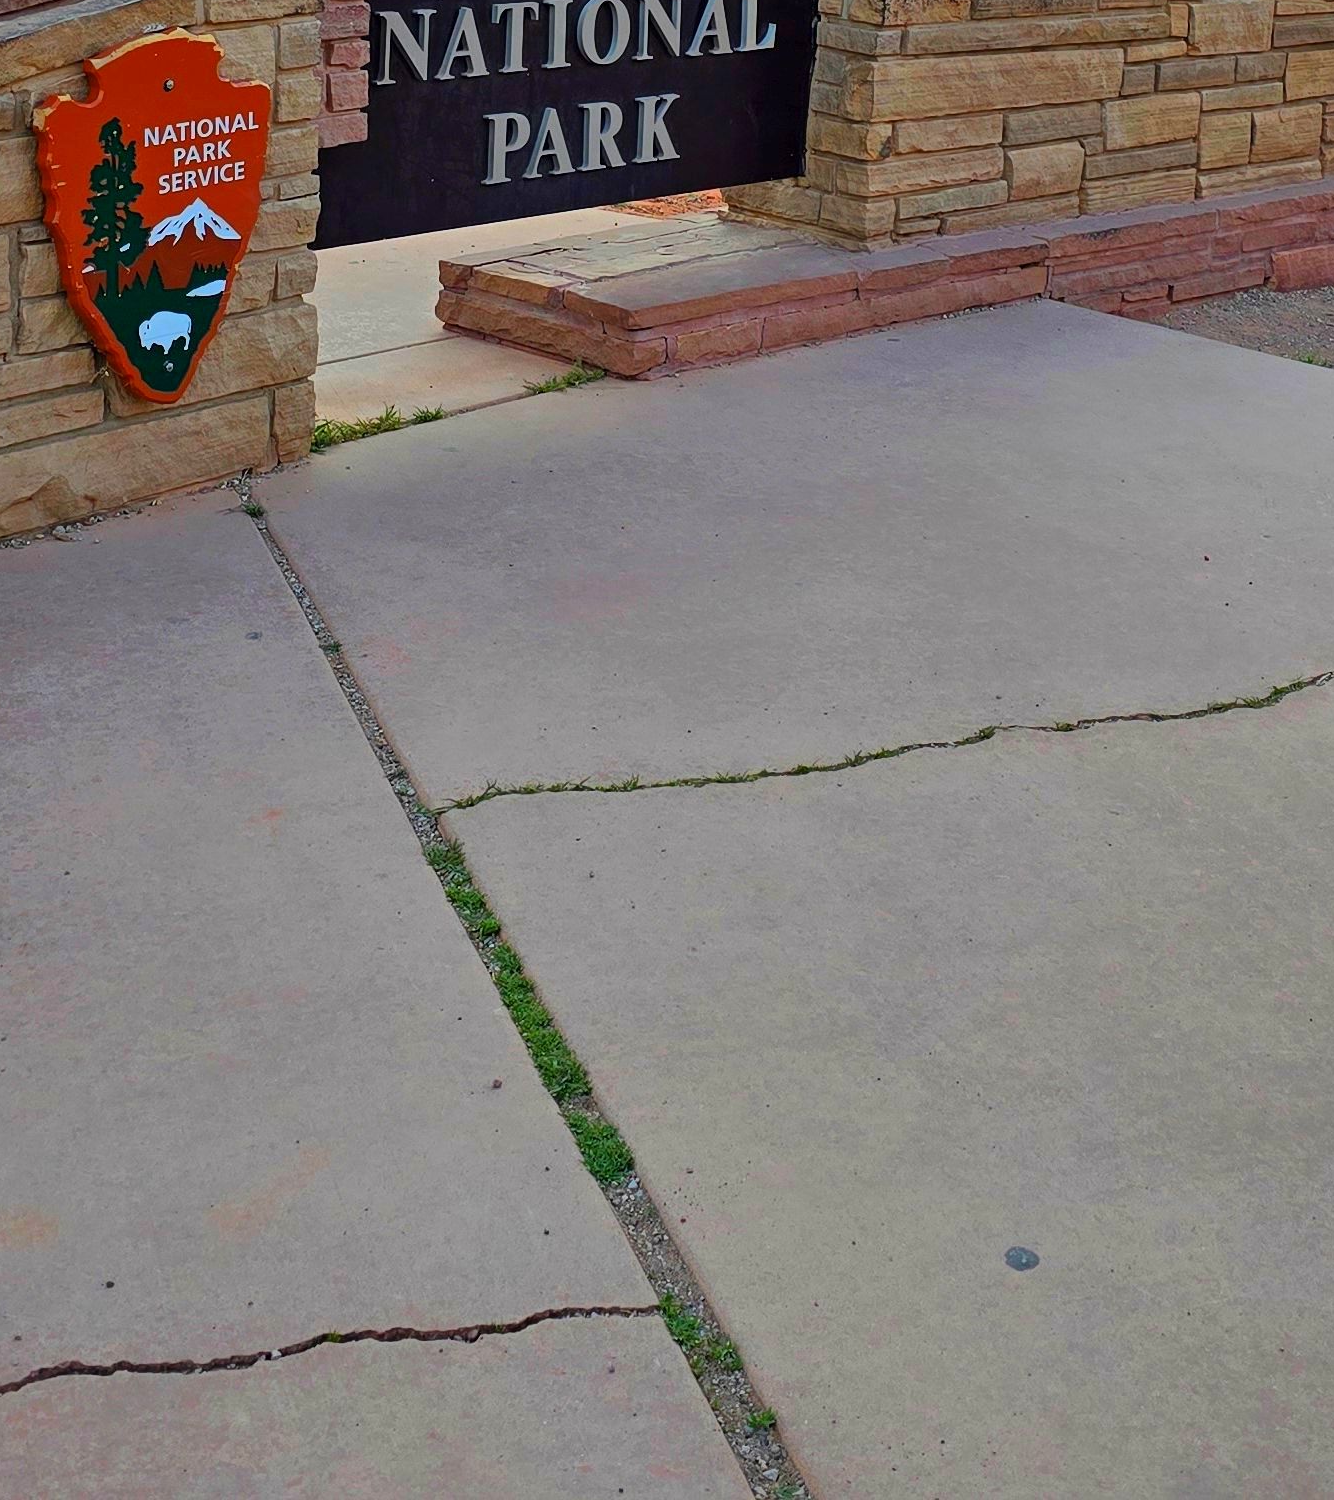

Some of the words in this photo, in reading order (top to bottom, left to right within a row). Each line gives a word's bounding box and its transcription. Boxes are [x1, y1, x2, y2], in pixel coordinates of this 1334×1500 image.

[143, 112, 259, 147] NATIONAL
[481, 93, 681, 185] PARK
[173, 139, 232, 167] PARK
[158, 161, 245, 195] SERVICE
